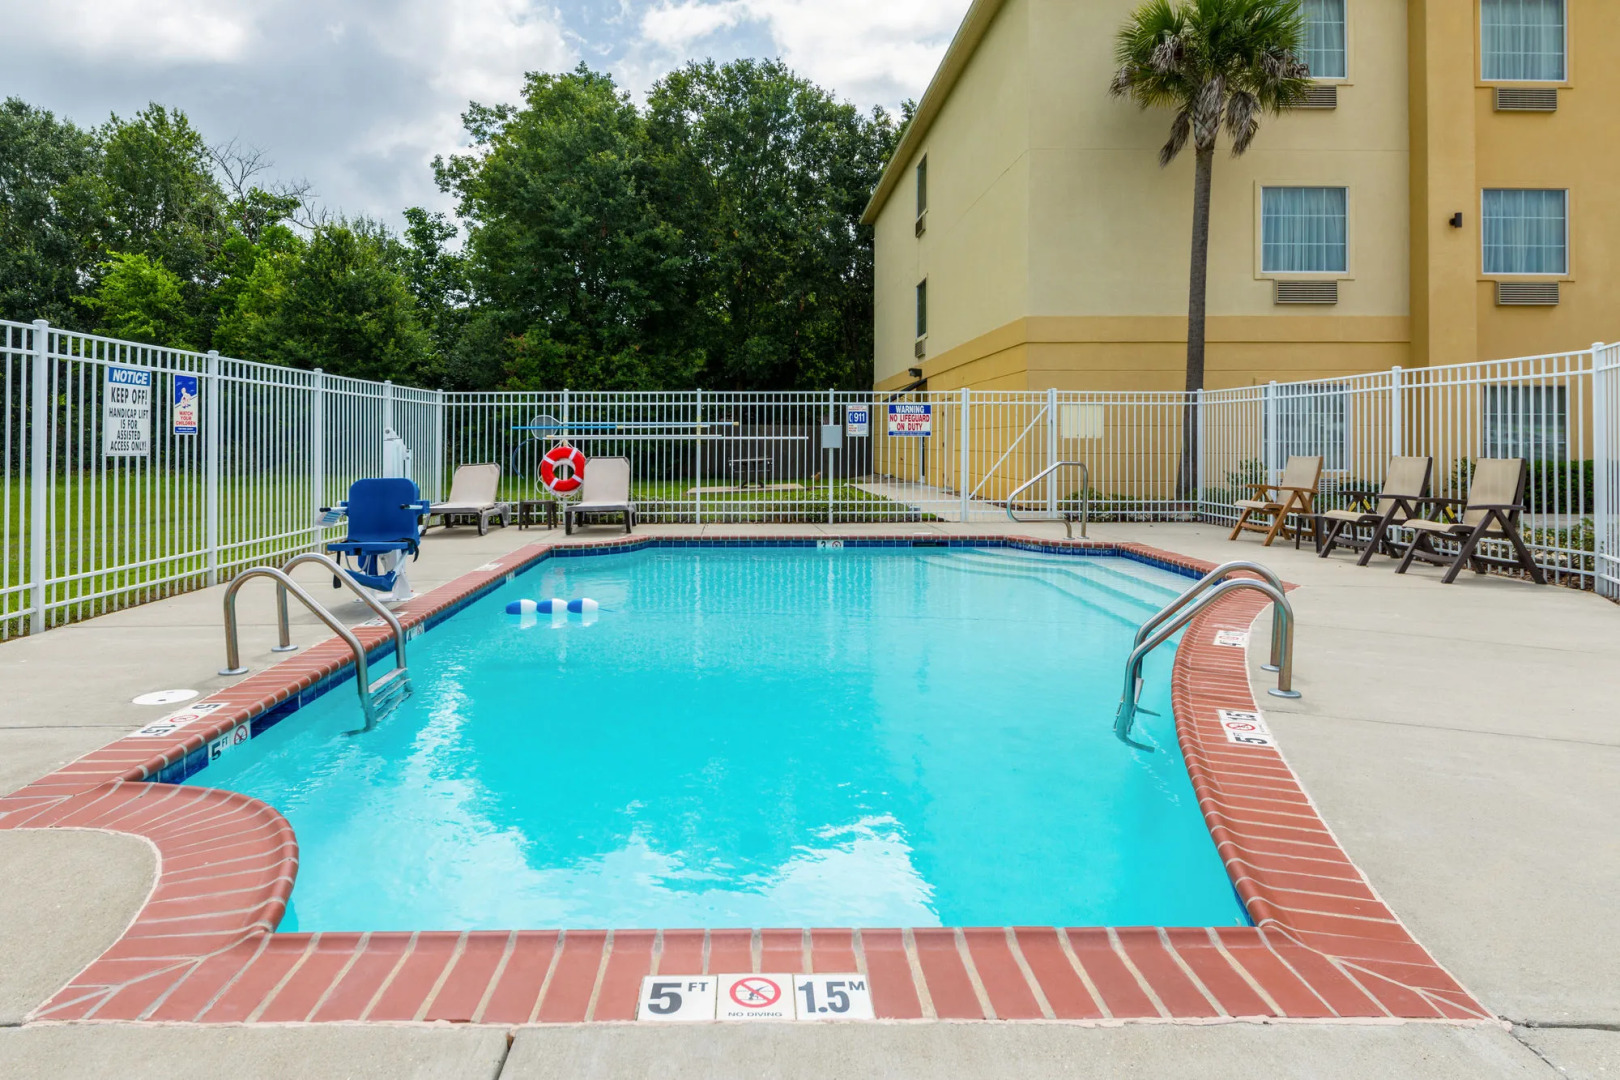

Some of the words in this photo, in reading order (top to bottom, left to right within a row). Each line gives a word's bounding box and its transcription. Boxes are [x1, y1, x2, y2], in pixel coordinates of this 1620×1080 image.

[113, 369, 148, 384] NOTICE
[111, 387, 128, 403] KEEP
[132, 389, 147, 405] OFF!
[109, 408, 137, 418] HANDICAP
[139, 410, 148, 419] LIFT
[854, 413, 865, 422] 911
[121, 419, 125, 429] IS
[128, 420, 138, 429] FOR
[117, 430, 140, 440] ASSISTED
[110, 441, 129, 451] ACCESS
[131, 441, 146, 451] ONLY!
